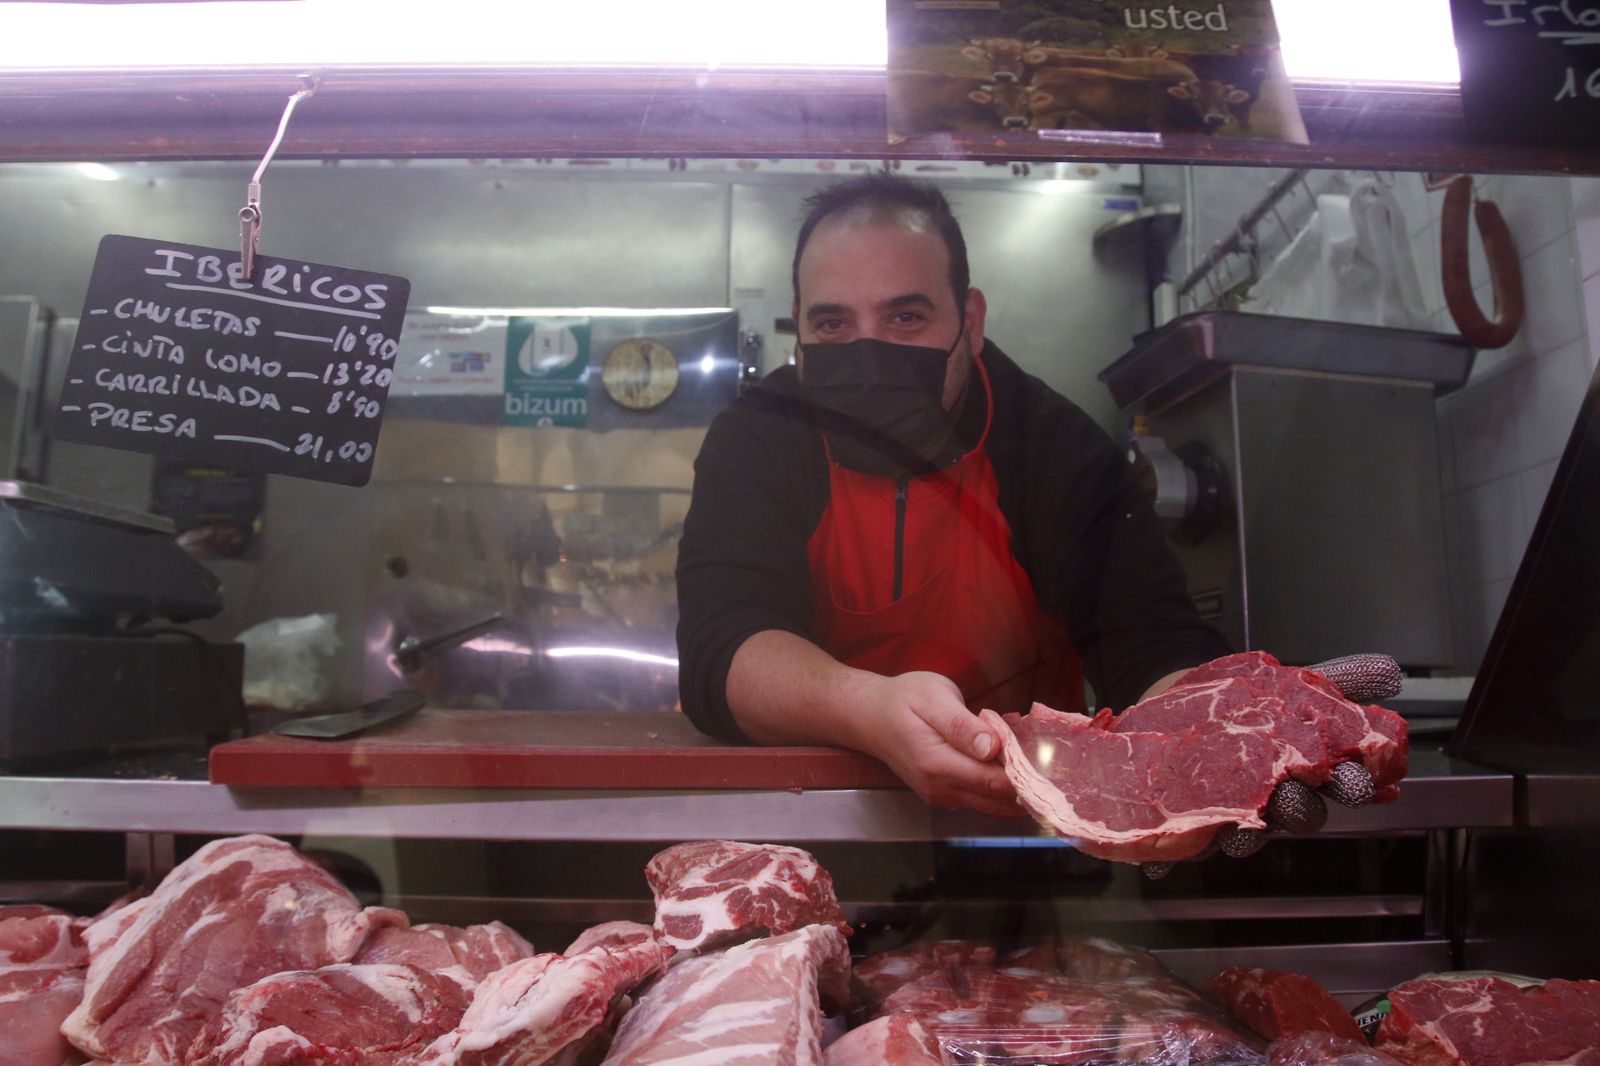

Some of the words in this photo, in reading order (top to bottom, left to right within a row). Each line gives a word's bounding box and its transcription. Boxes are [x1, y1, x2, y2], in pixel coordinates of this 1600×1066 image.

[1123, 3, 1228, 32] usted
[114, 298, 261, 337] CHULETAS
[323, 361, 393, 387] 13'20
[505, 393, 588, 416] bizum
[88, 403, 196, 438] PRESA
[294, 432, 373, 463] 21,00
